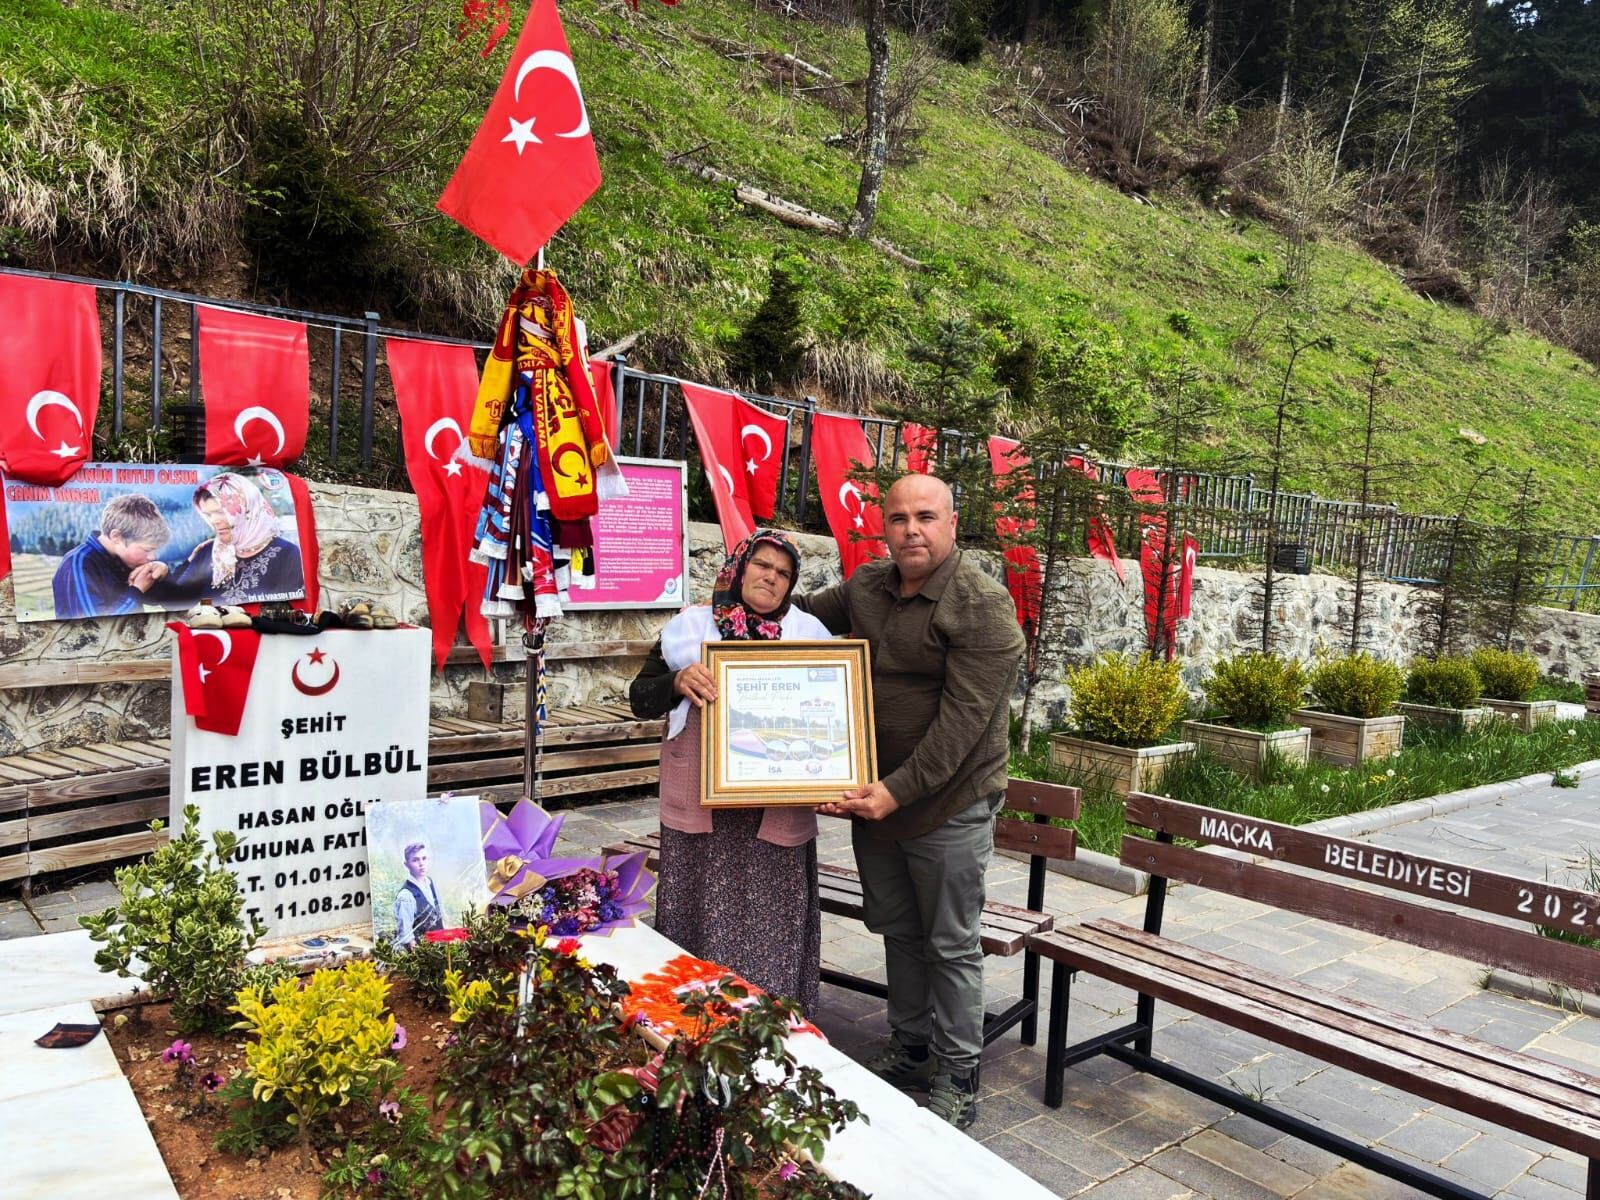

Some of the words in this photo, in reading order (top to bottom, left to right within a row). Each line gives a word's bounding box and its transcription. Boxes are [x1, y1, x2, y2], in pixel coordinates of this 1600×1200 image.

[535, 394, 547, 448] VATANA
[116, 468, 155, 484] KUTLU
[158, 469, 198, 486] OLSUN
[6, 486, 51, 502] CANIM
[54, 488, 100, 504] ANNEM
[736, 680, 768, 694] ŞEHİT
[771, 681, 800, 691] EREN
[281, 711, 347, 739] ŞEHİT
[191, 760, 284, 793] EREN
[299, 745, 422, 782] BÜLBÜL
[238, 805, 316, 830] HASAN
[324, 798, 381, 820] OĞL
[323, 826, 367, 851] FATİ
[274, 860, 370, 889] 01.01.20
[1200, 816, 1275, 852] MAÇKA
[1517, 888, 1600, 926] 202
[274, 891, 372, 919] 11.08.20
